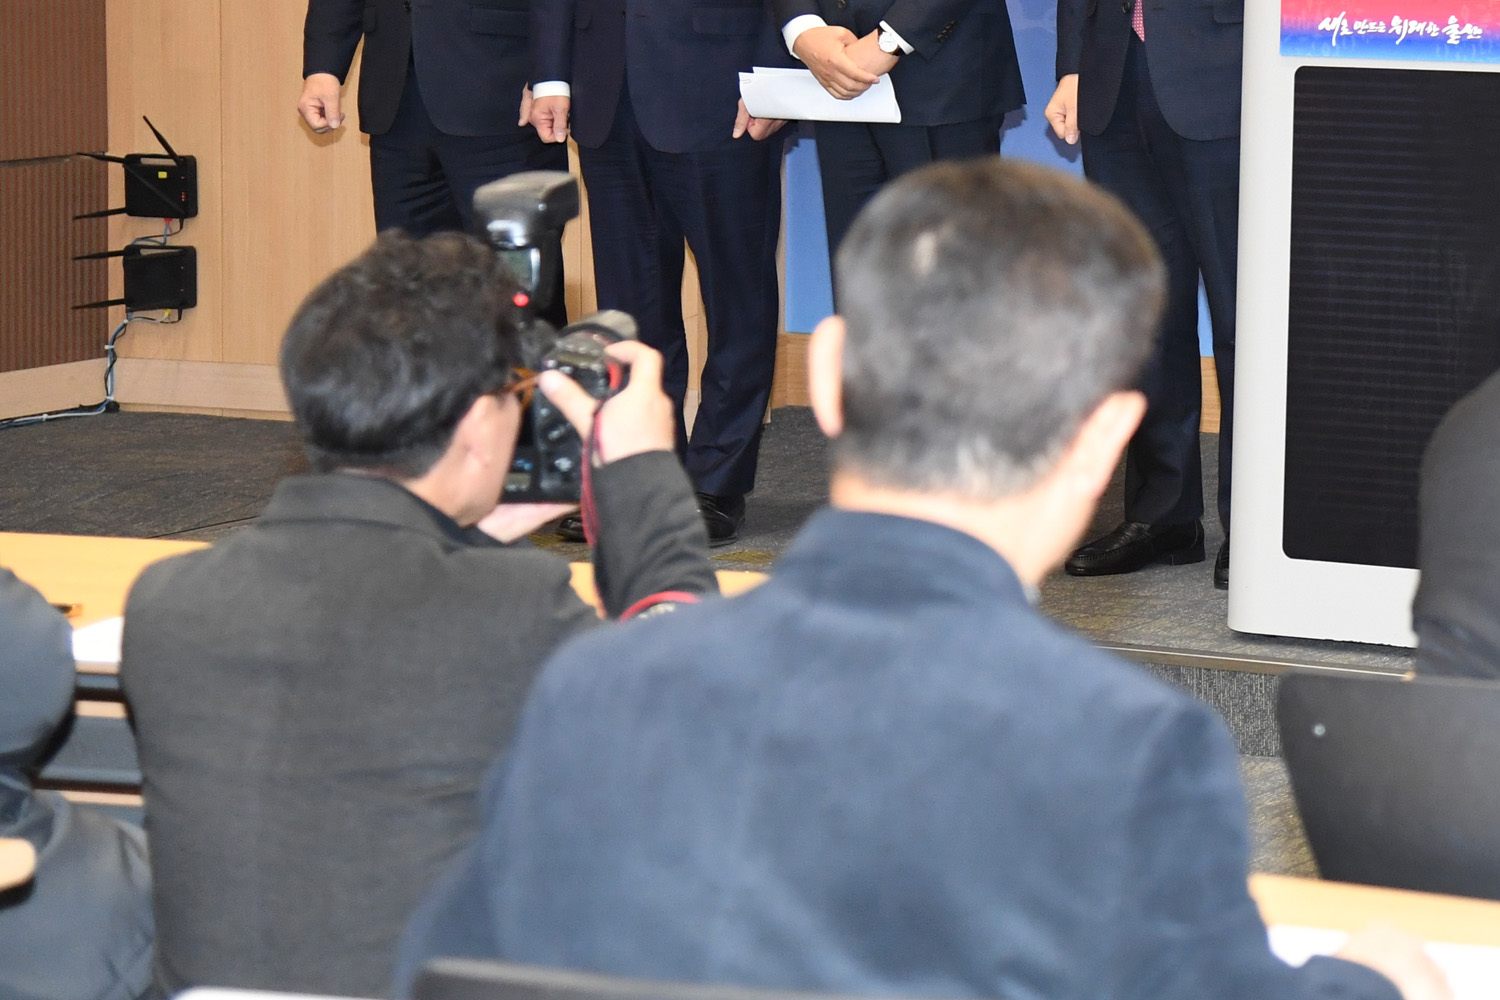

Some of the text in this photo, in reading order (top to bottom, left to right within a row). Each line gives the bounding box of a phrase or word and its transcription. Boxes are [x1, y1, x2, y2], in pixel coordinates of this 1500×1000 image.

[1317, 11, 1483, 47] 새로 만드는 위대한 울산
